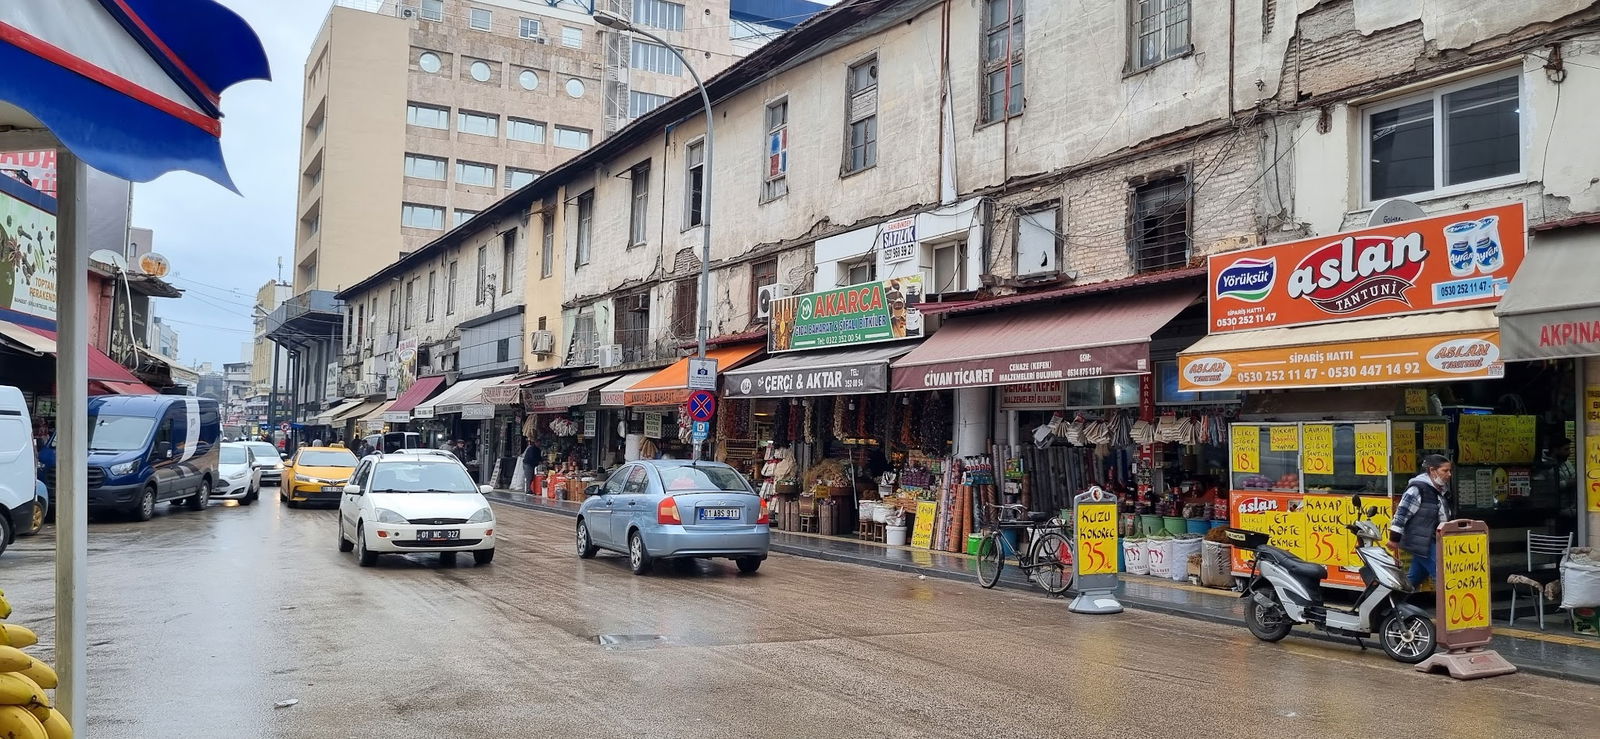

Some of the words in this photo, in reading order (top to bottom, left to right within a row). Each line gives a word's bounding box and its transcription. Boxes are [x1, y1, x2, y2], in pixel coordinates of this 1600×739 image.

[884, 227, 914, 249] SATILIK
[1287, 232, 1427, 298] aslan
[1223, 270, 1269, 288] Yörüksüt
[1335, 281, 1397, 311] TANTUNİ
[1441, 285, 1456, 297] 0530
[1457, 284, 1468, 295] 252
[1470, 282, 1478, 293] 11
[1479, 281, 1487, 292] 47
[813, 286, 883, 318] AKARCA
[1216, 317, 1237, 327] 0530
[1238, 315, 1254, 325] 252
[1255, 314, 1264, 323] 11
[1265, 312, 1277, 322] 47
[1289, 351, 1324, 364] SİPARİŞ
[1326, 350, 1353, 361] HATTI
[1434, 343, 1491, 360] ASLAN
[1009, 362, 1029, 372] CENAZE
[1237, 371, 1263, 383] 0530
[1265, 370, 1285, 381] 252
[1288, 369, 1300, 380] 11
[1304, 368, 1318, 380] 47
[1328, 366, 1356, 378] 0530
[1359, 364, 1382, 376] 447
[1386, 363, 1401, 375] 14
[1404, 362, 1420, 374] 92
[796, 373, 804, 390] &
[806, 370, 843, 389] AKTAR
[924, 370, 953, 387] CİVAN
[954, 368, 994, 385] TİCARET
[1036, 370, 1063, 380] BULUNUR
[1238, 497, 1278, 513] aslan
[1306, 499, 1342, 511] KASAP
[704, 509, 712, 517] 01
[726, 509, 738, 517] 911
[1082, 508, 1111, 523] KUZU
[1274, 514, 1288, 524] ET
[1306, 513, 1345, 525] SUCUK
[421, 530, 429, 539] 01
[447, 530, 459, 538] 327
[1080, 526, 1115, 540] KOKOREÇ
[1312, 525, 1345, 535] EKMEK
